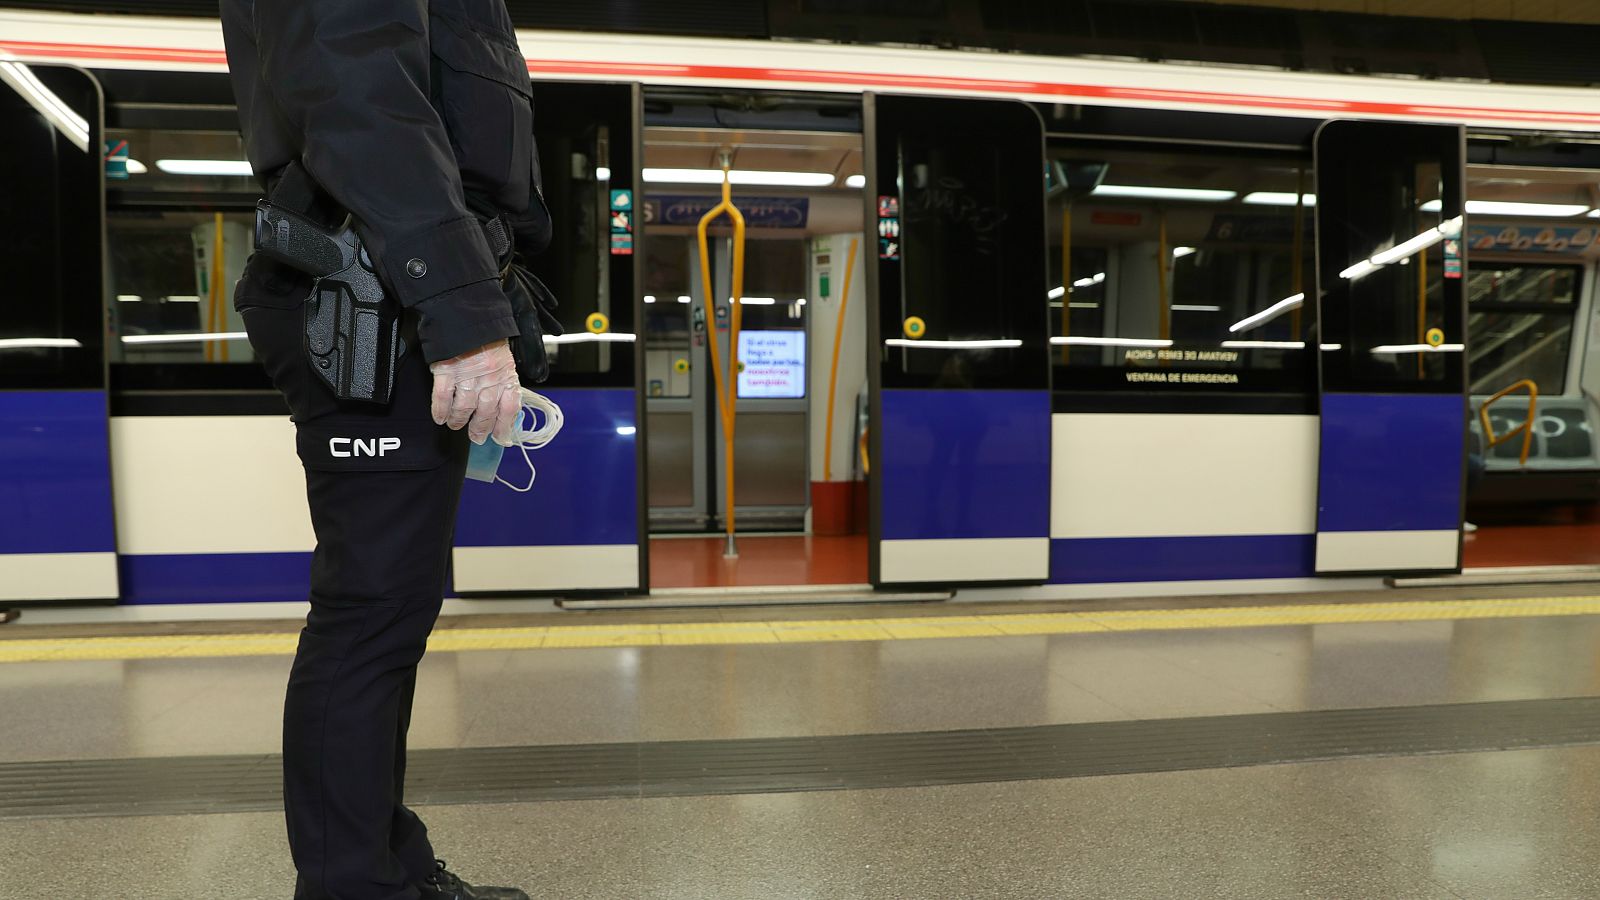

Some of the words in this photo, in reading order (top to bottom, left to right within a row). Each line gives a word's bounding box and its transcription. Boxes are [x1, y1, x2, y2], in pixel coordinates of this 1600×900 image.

[1126, 372, 1168, 382] VENTANA
[1168, 373, 1181, 382] DE
[1182, 373, 1239, 383] EMERGENCIA
[329, 437, 401, 457] CNP
